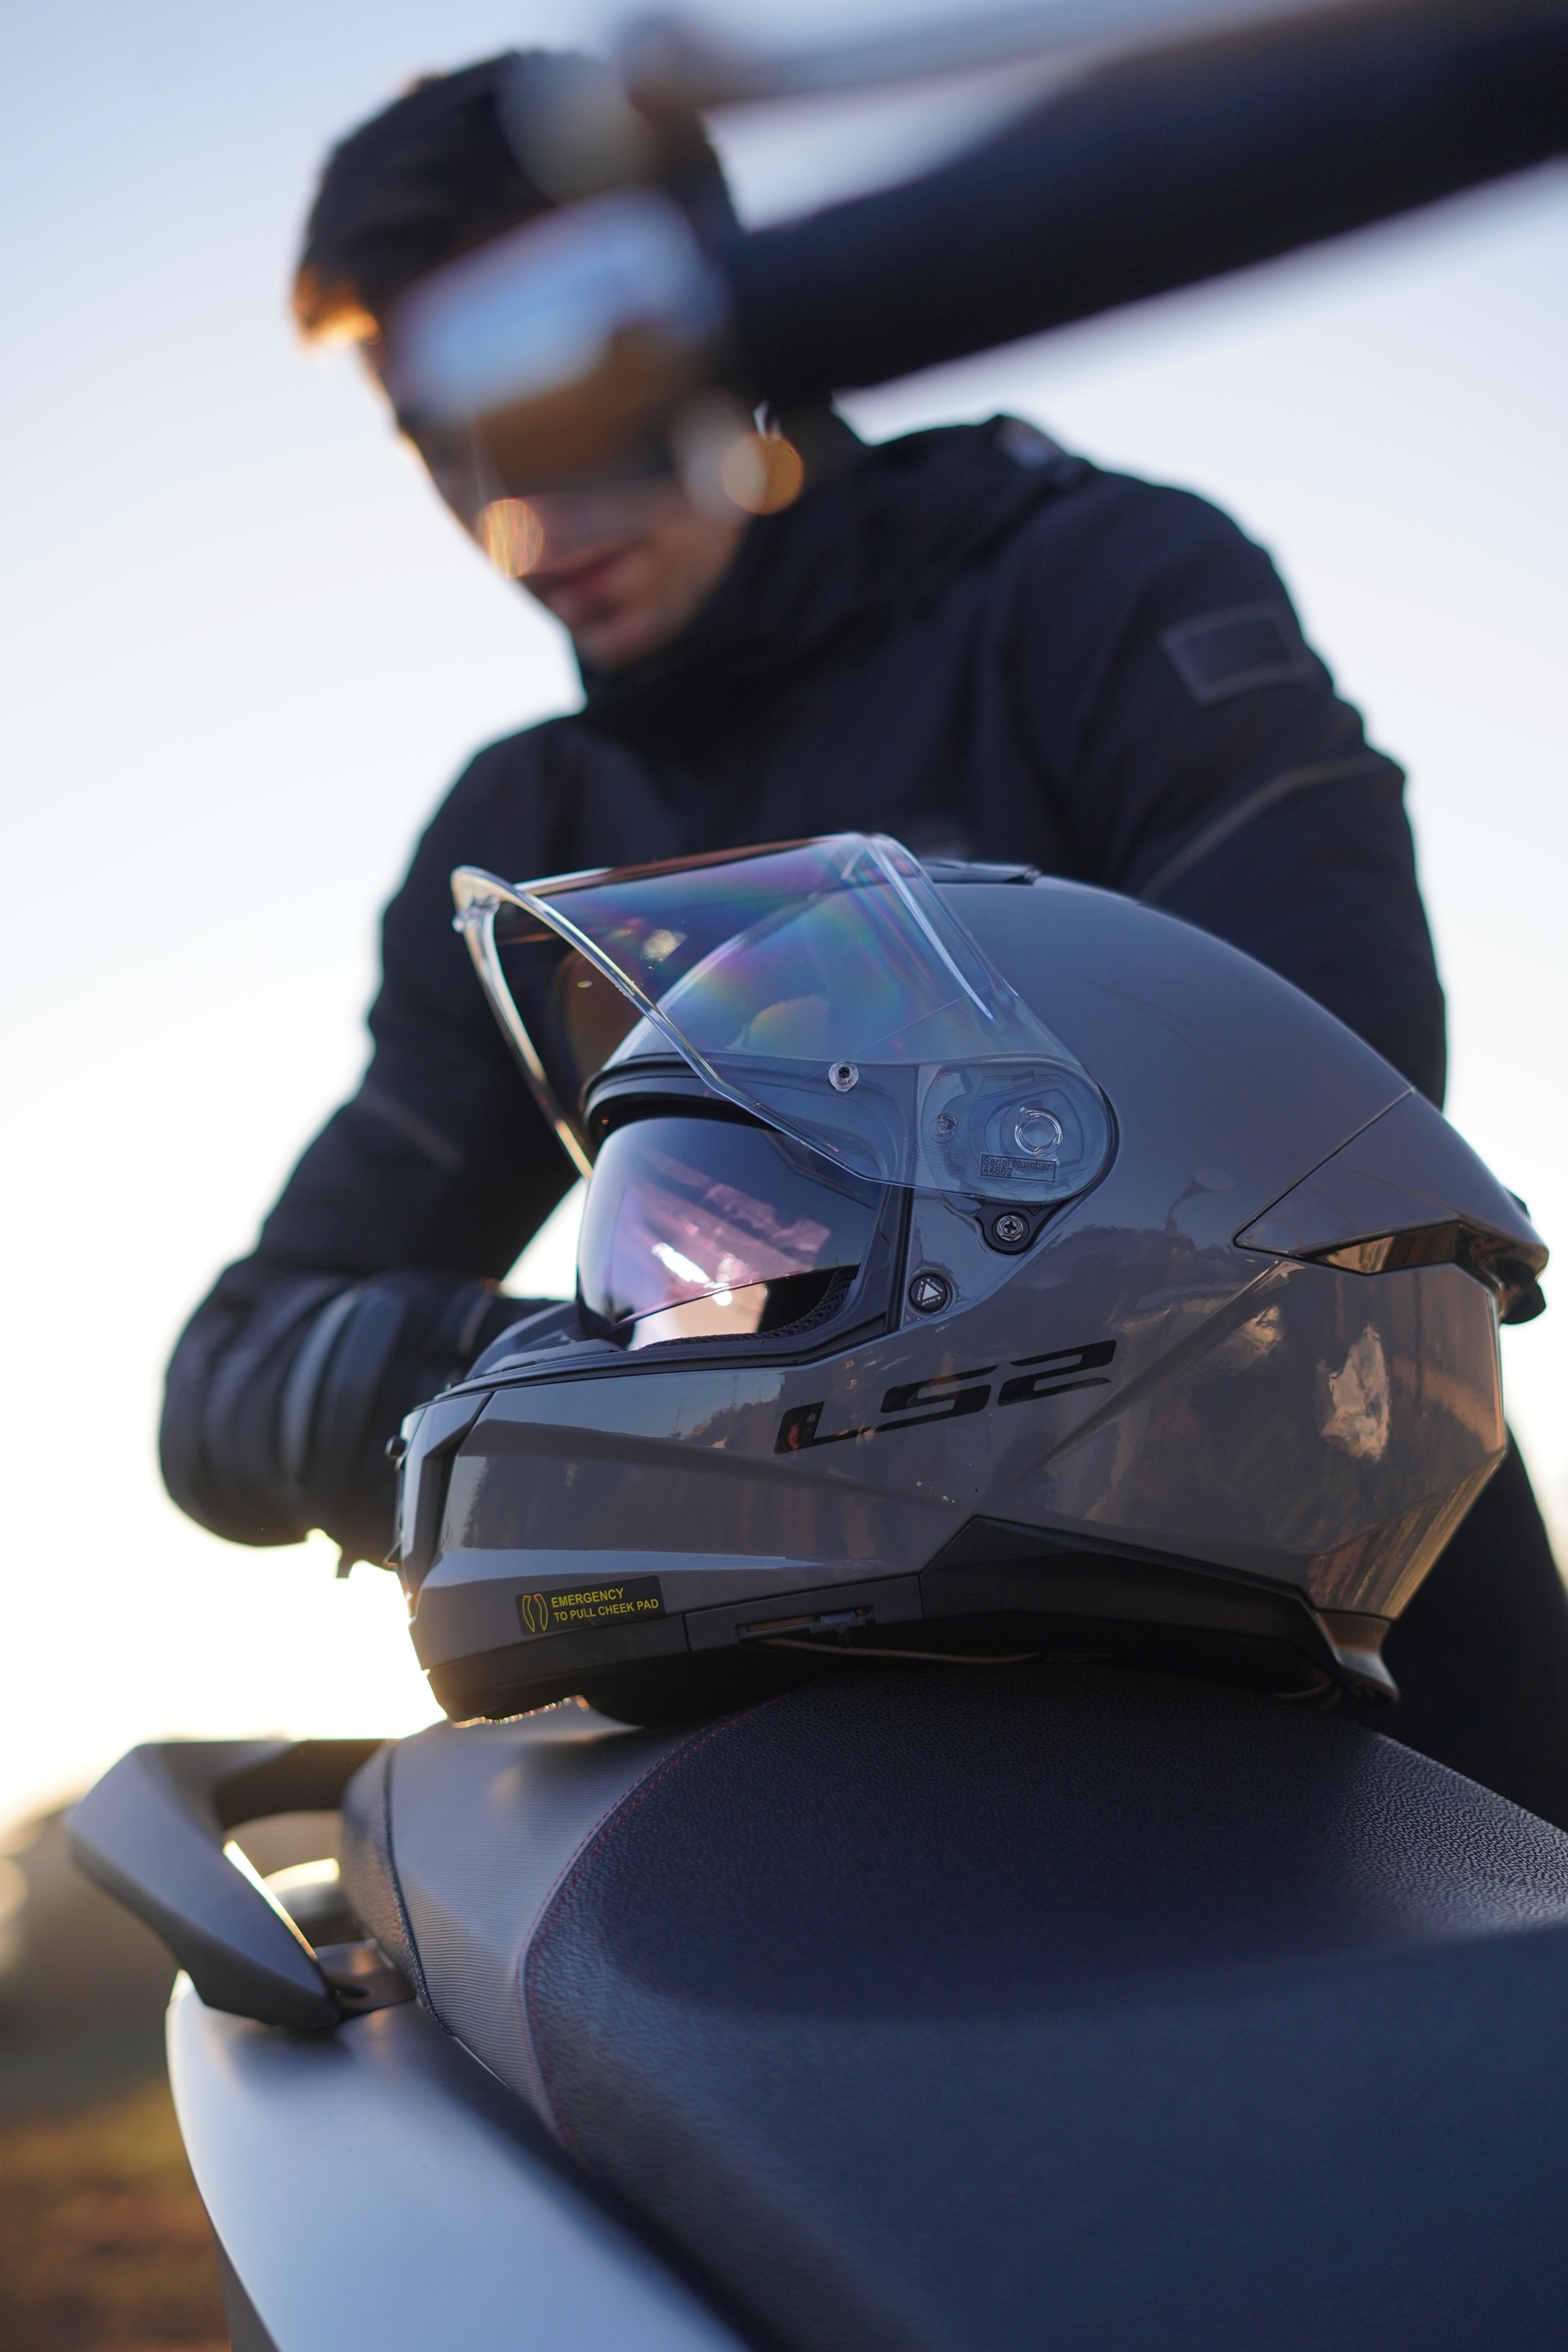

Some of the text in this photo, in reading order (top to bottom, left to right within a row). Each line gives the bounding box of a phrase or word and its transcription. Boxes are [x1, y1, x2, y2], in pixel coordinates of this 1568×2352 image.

[982, 1156, 1010, 1167] Serial
[774, 1339, 1117, 1454] LS2
[551, 1588, 624, 1608] EMERGENCY
[554, 1599, 659, 1622] TO PULL CHEEK PAD
